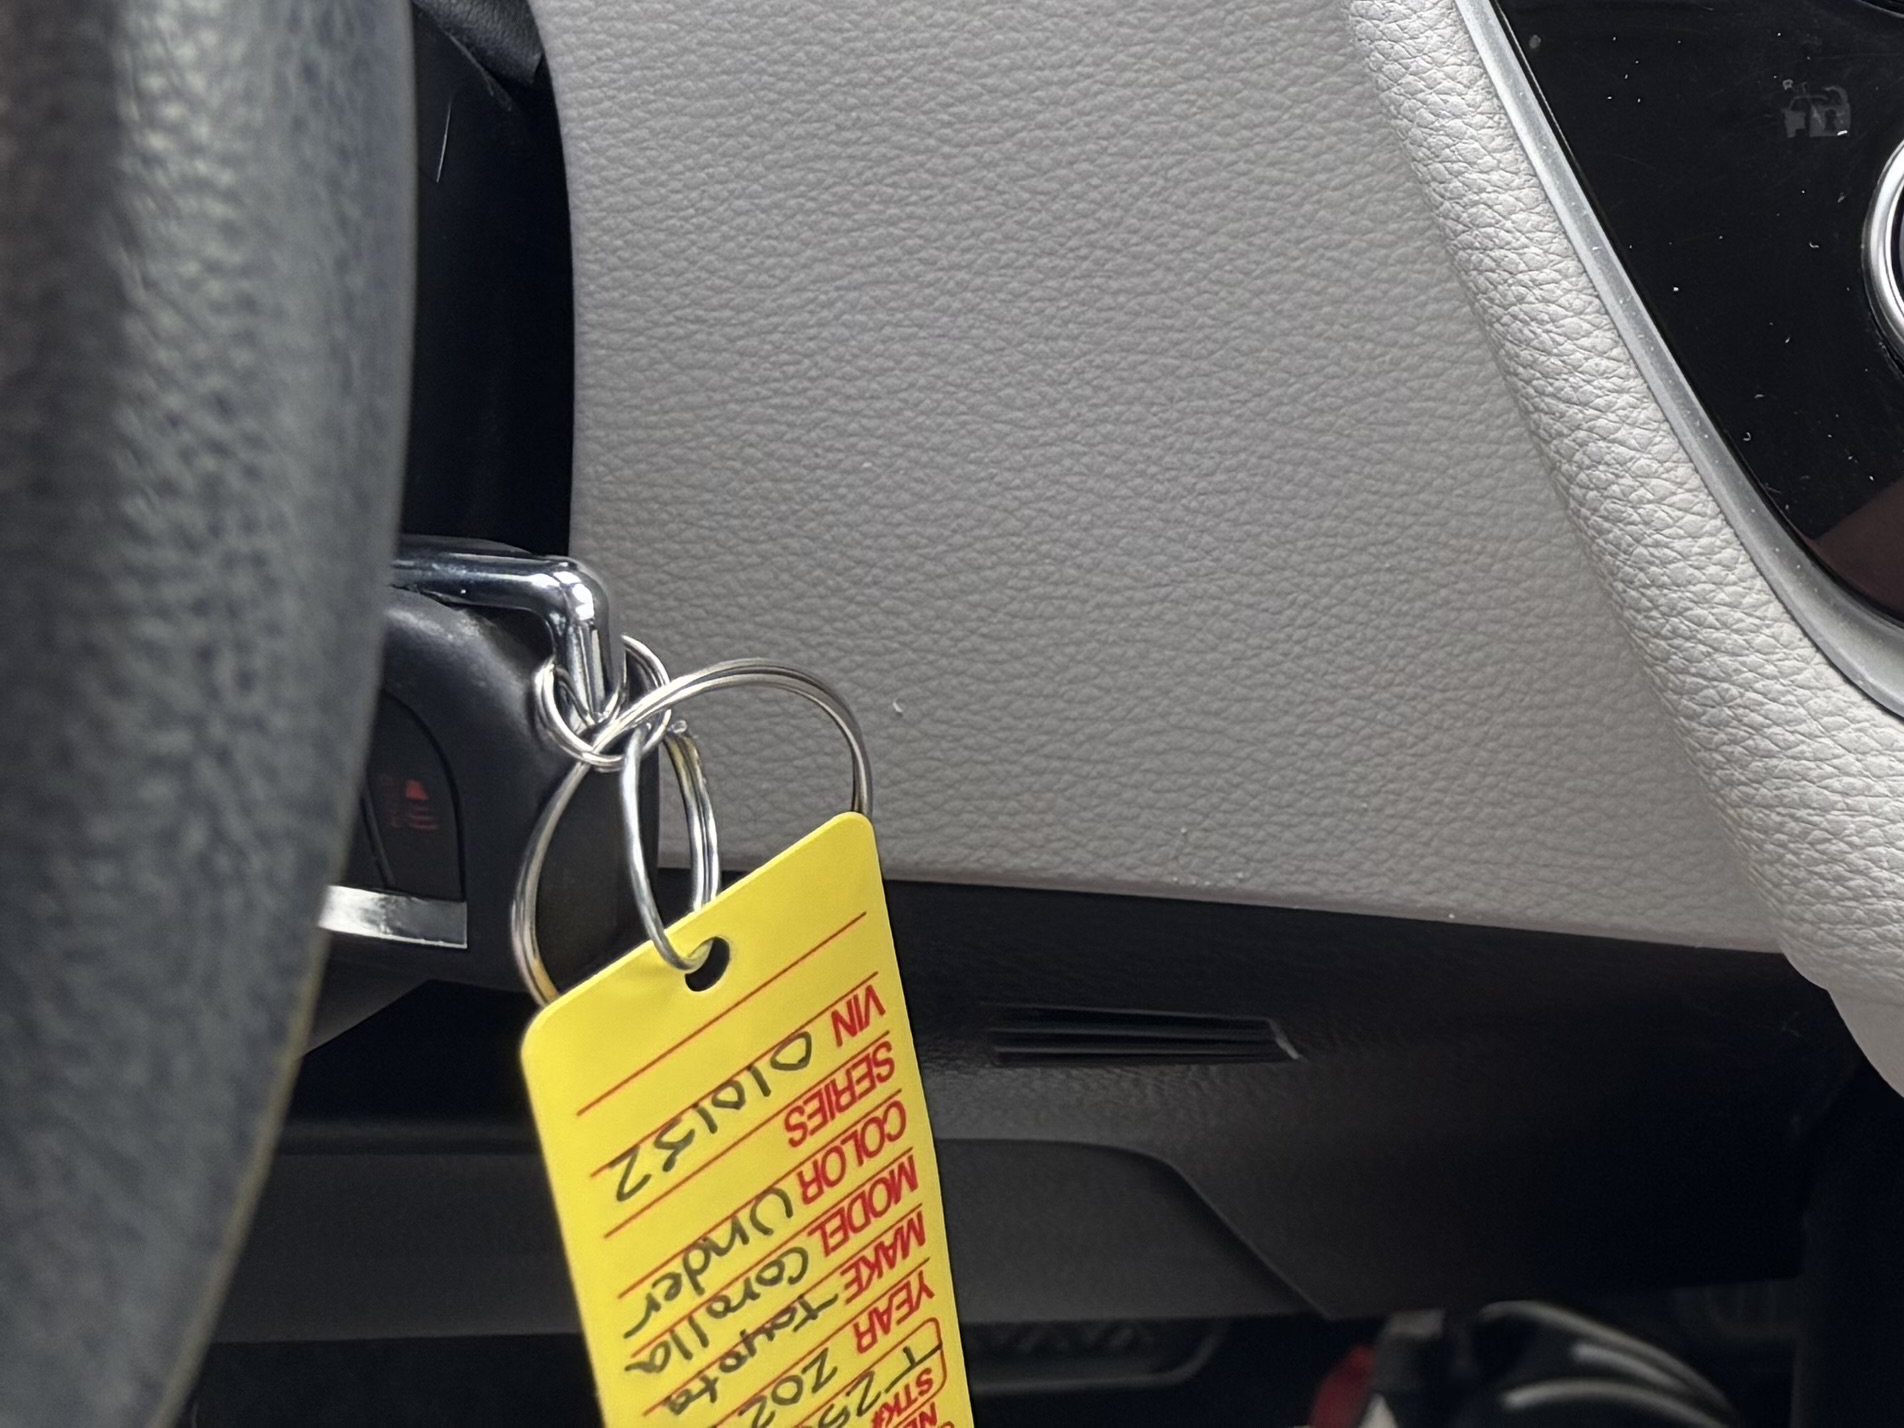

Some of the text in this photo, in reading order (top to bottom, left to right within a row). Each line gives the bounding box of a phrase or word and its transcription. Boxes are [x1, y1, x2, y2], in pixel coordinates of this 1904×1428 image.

[830, 984, 887, 1047] VIN
[784, 1040, 896, 1148] SERIES
[797, 1100, 908, 1205] COLOR
[625, 1154, 919, 1373] MODEL Corolla
[840, 1211, 927, 1304] MAKE
[852, 1271, 935, 1355] YEAR
